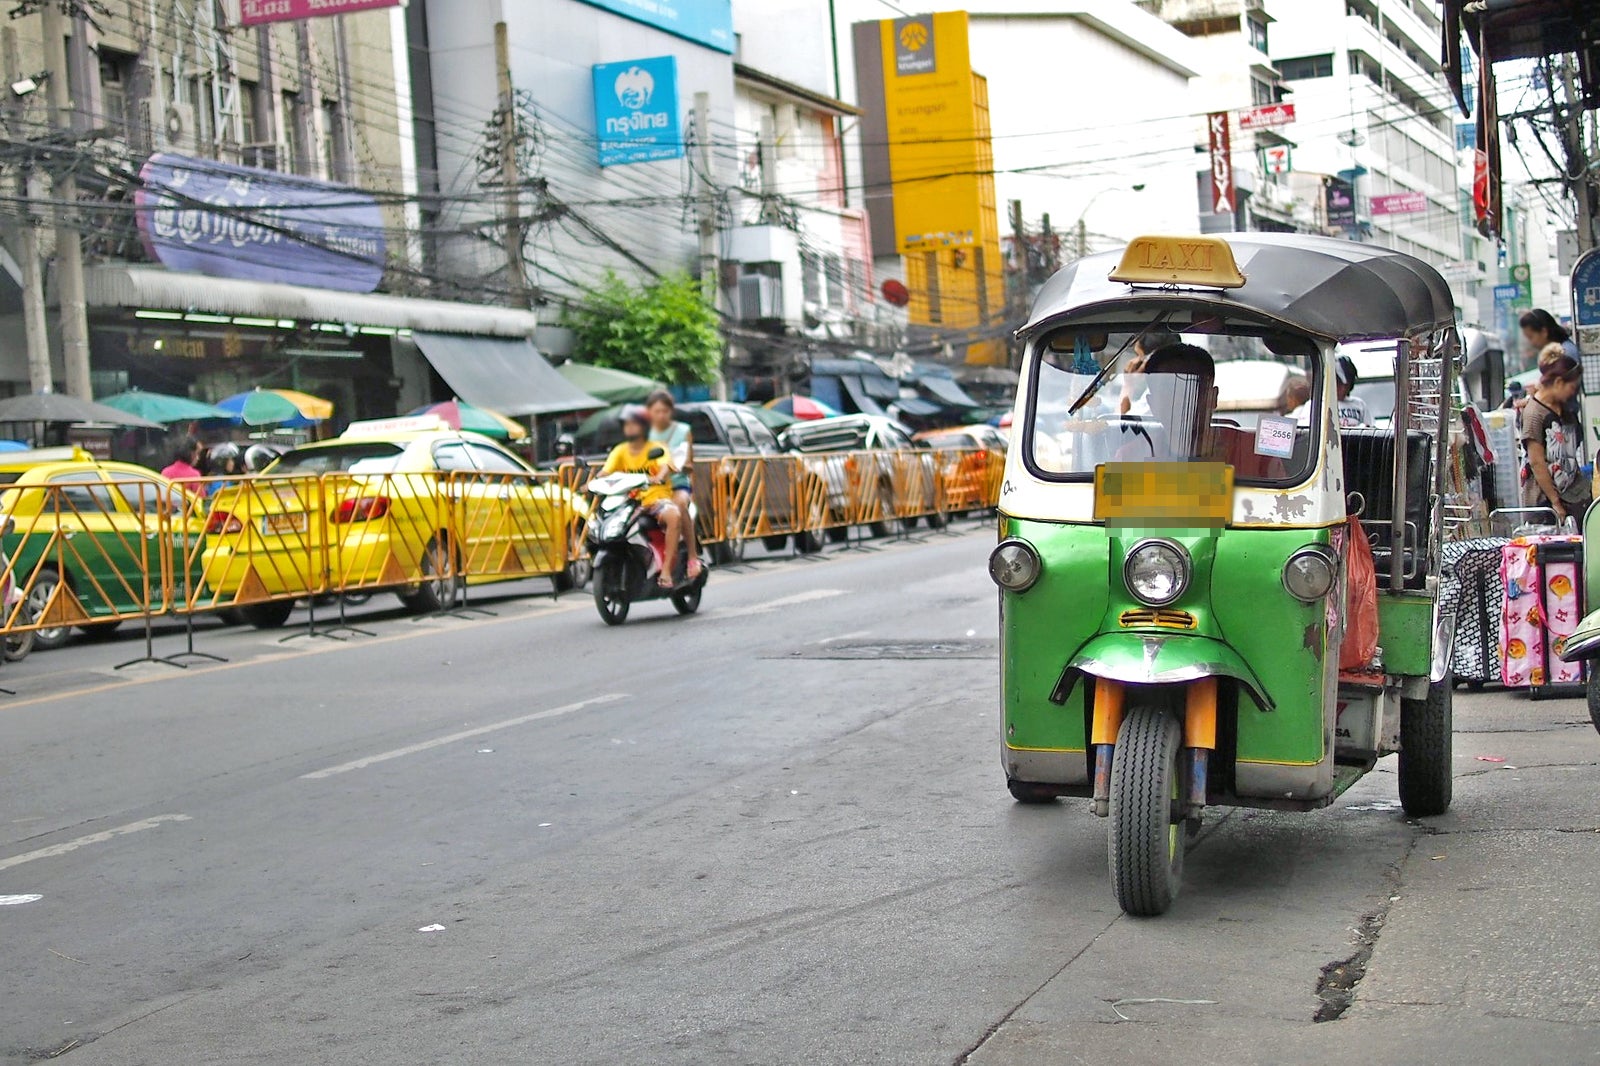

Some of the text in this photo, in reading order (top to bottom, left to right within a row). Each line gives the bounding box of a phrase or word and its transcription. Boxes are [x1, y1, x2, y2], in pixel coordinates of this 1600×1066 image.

[606, 111, 669, 136] กรุงไทย
[1135, 241, 1214, 271] TAXI
[1272, 429, 1292, 440] 2556
